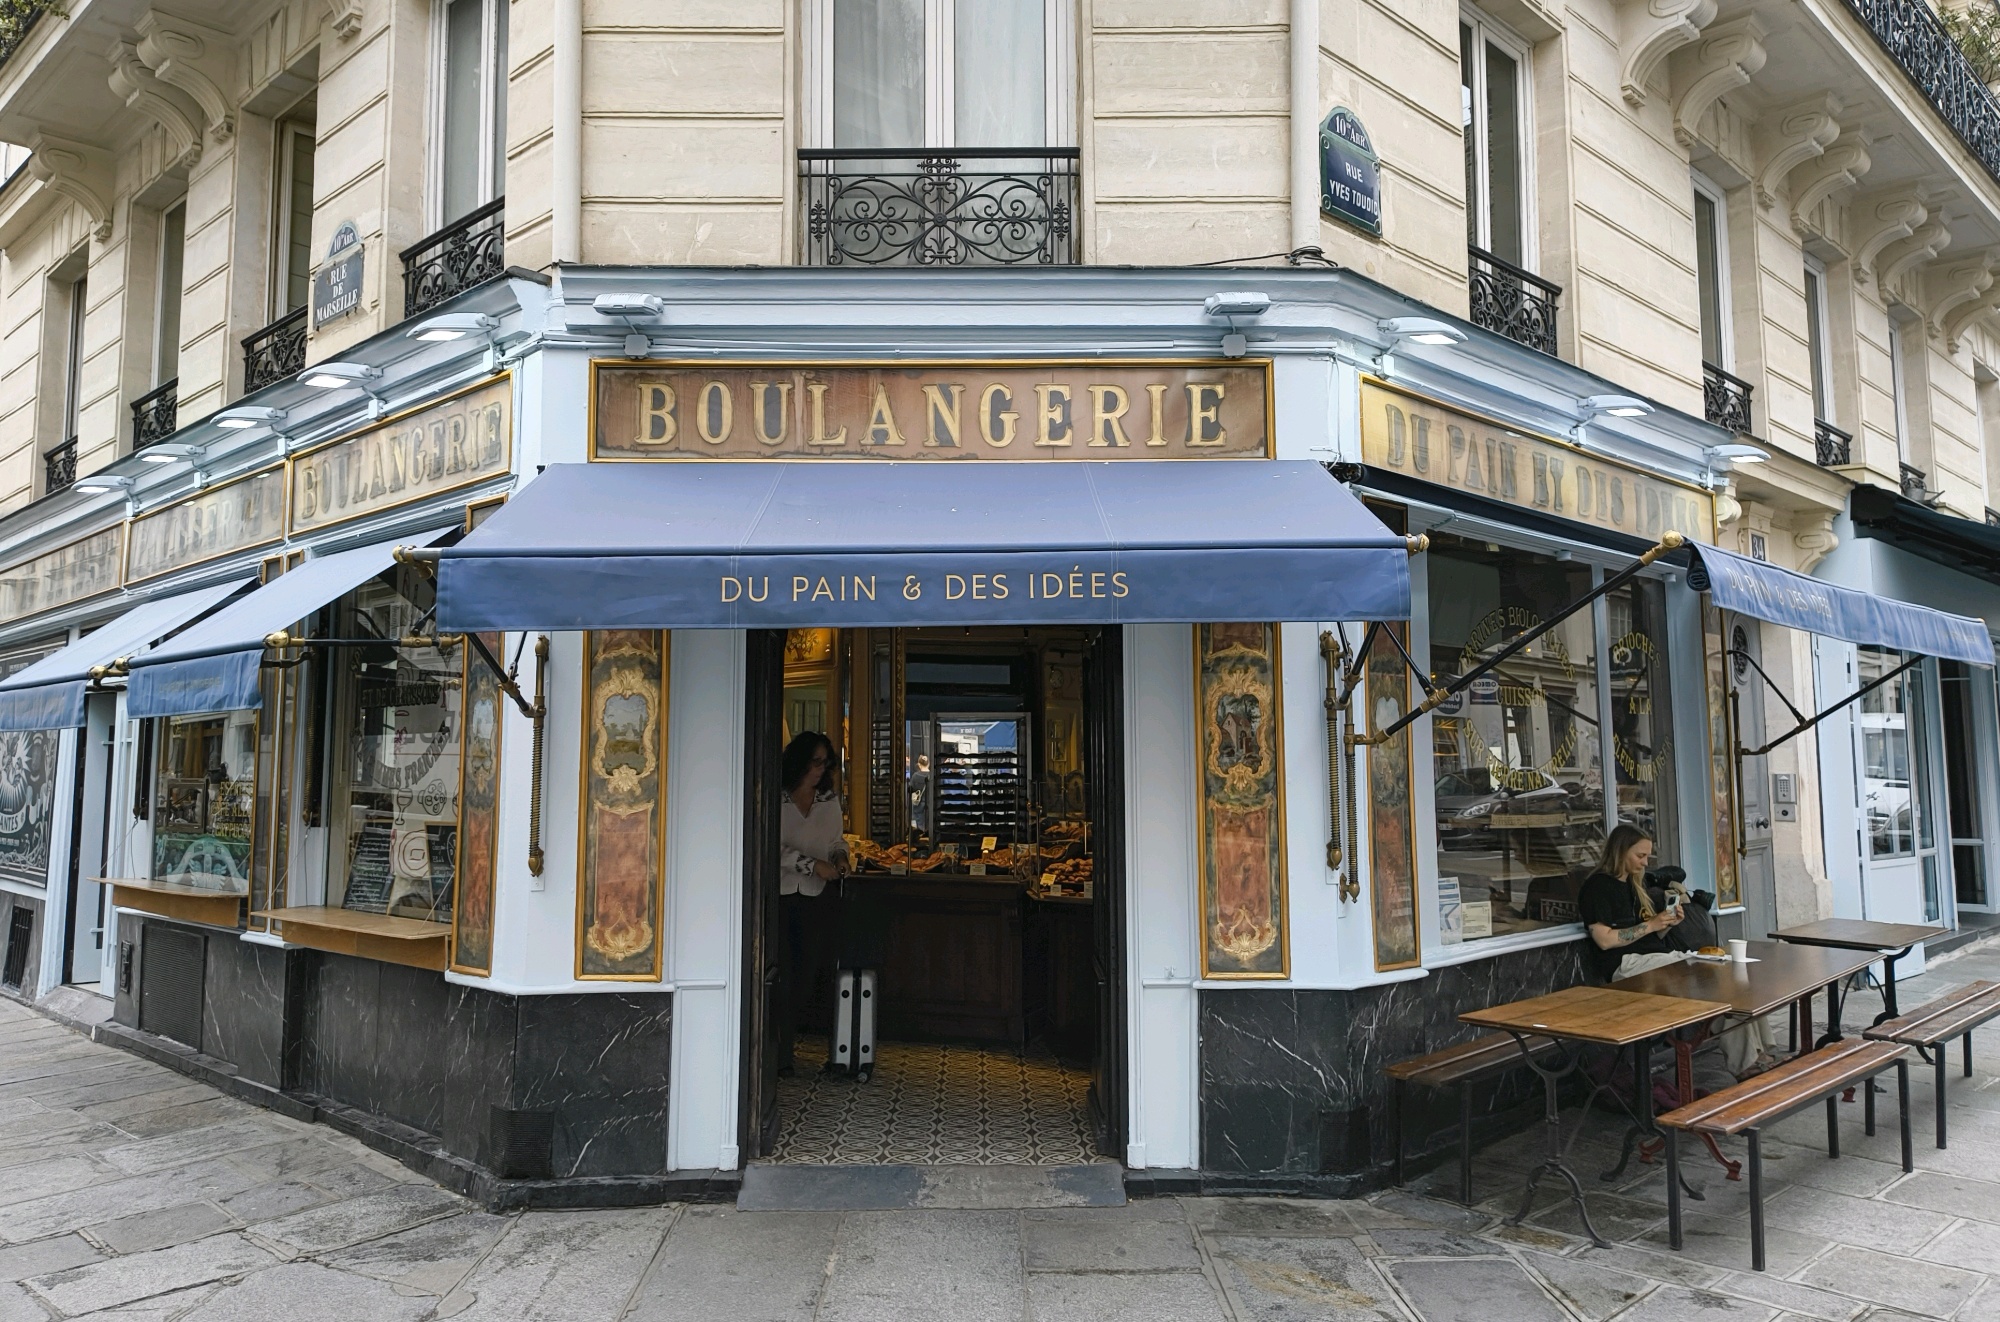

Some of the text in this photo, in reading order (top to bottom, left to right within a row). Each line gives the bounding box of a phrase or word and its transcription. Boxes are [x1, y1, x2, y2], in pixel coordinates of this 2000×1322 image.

[1345, 162, 1363, 183] RUE
[1329, 179, 1378, 216] YVES TOUDIC
[330, 264, 347, 286] RUE
[333, 283, 344, 299] DE
[316, 288, 358, 321] MARSEILLE
[634, 381, 1226, 448] BOULANGERIE
[302, 402, 502, 519] BOULANGERIE
[1385, 403, 1431, 474] DU
[1447, 424, 1518, 499] PAIN
[1532, 451, 1565, 512] ET
[1576, 465, 1625, 525] DES
[1752, 536, 1764, 560] 34
[721, 565, 1130, 602] DU PAIN & DES IDÉES
[1725, 567, 1744, 592] DU
[1459, 606, 1576, 681] FARINES BIOLOIQUES
[1613, 631, 1661, 668] BRIOCHES
[1496, 686, 1548, 708] CUISSON
[1640, 697, 1652, 715] LA
[1463, 718, 1578, 792] SUR PIERRE NATURELLE
[1613, 733, 1635, 779] FLEUR
